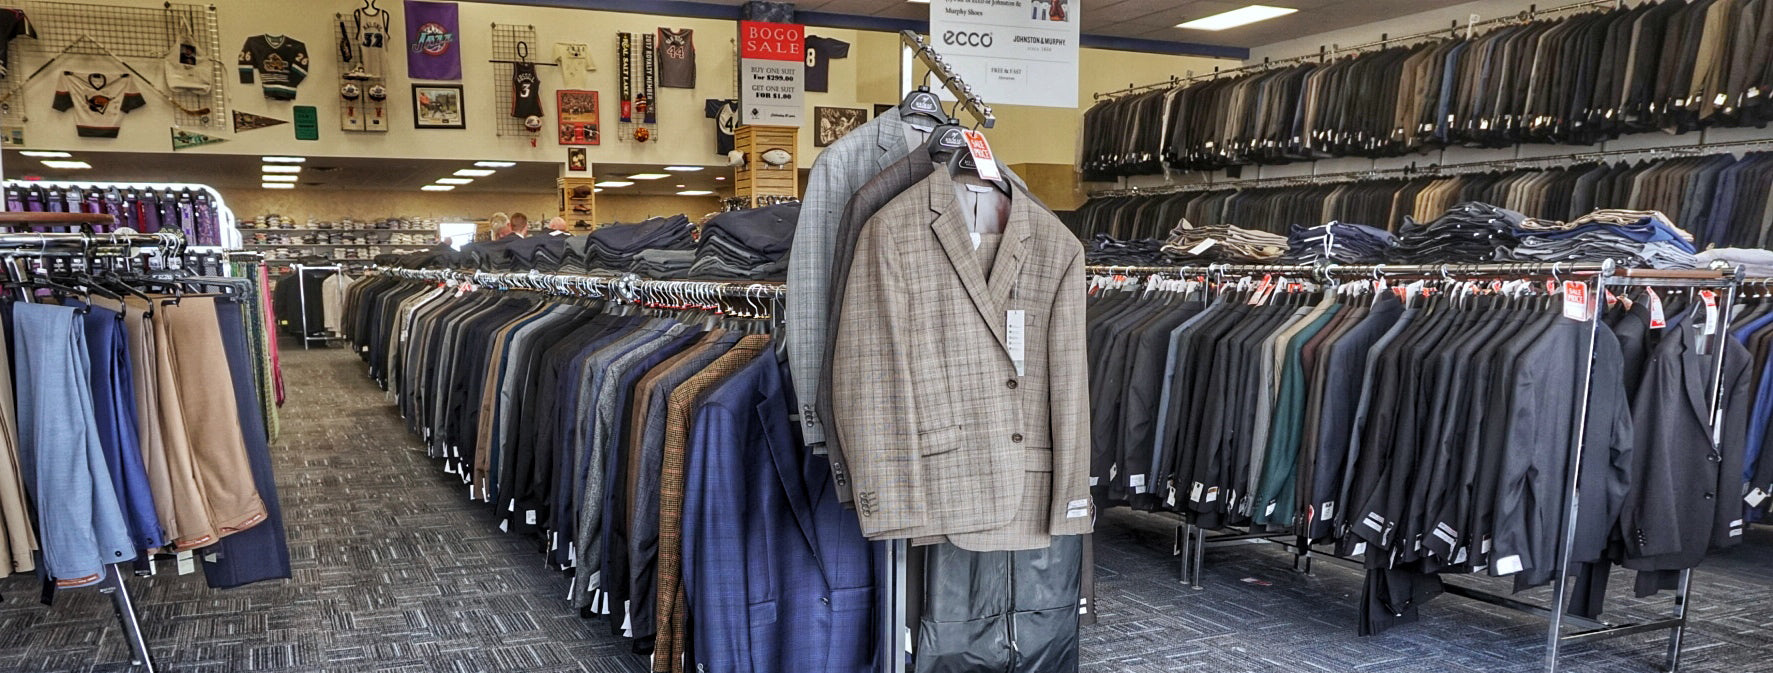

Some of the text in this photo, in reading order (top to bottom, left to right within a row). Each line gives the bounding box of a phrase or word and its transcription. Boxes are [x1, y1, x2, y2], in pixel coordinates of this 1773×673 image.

[945, 7, 966, 16] Murphy
[362, 32, 383, 48] 32
[749, 26, 798, 41] BOGO
[943, 30, 993, 48] ecco
[666, 45, 685, 59] 44
[747, 40, 799, 54] SALE
[239, 51, 251, 61] 26
[295, 53, 309, 65] 26
[806, 48, 816, 67] 8
[520, 83, 531, 98] 3
[970, 139, 985, 149] SALE
[974, 149, 992, 159] PRICE
[1568, 288, 1582, 296] SALE
[1568, 295, 1584, 303] PRICE
